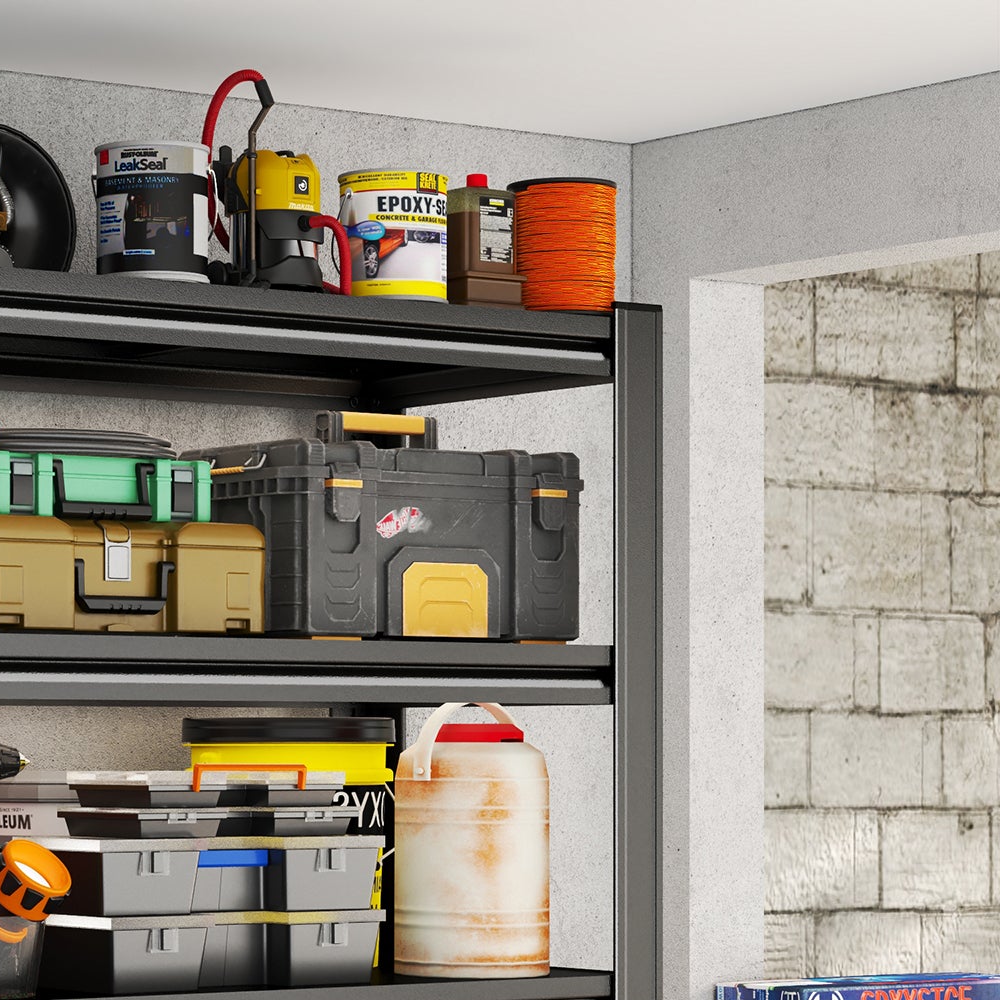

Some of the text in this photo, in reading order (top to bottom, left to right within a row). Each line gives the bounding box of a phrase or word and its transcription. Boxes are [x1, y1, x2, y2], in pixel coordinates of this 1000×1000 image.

[114, 157, 168, 172] LeakSeal
[377, 195, 448, 216] EPOXY-SE
[376, 214, 409, 222] CONCRETE
